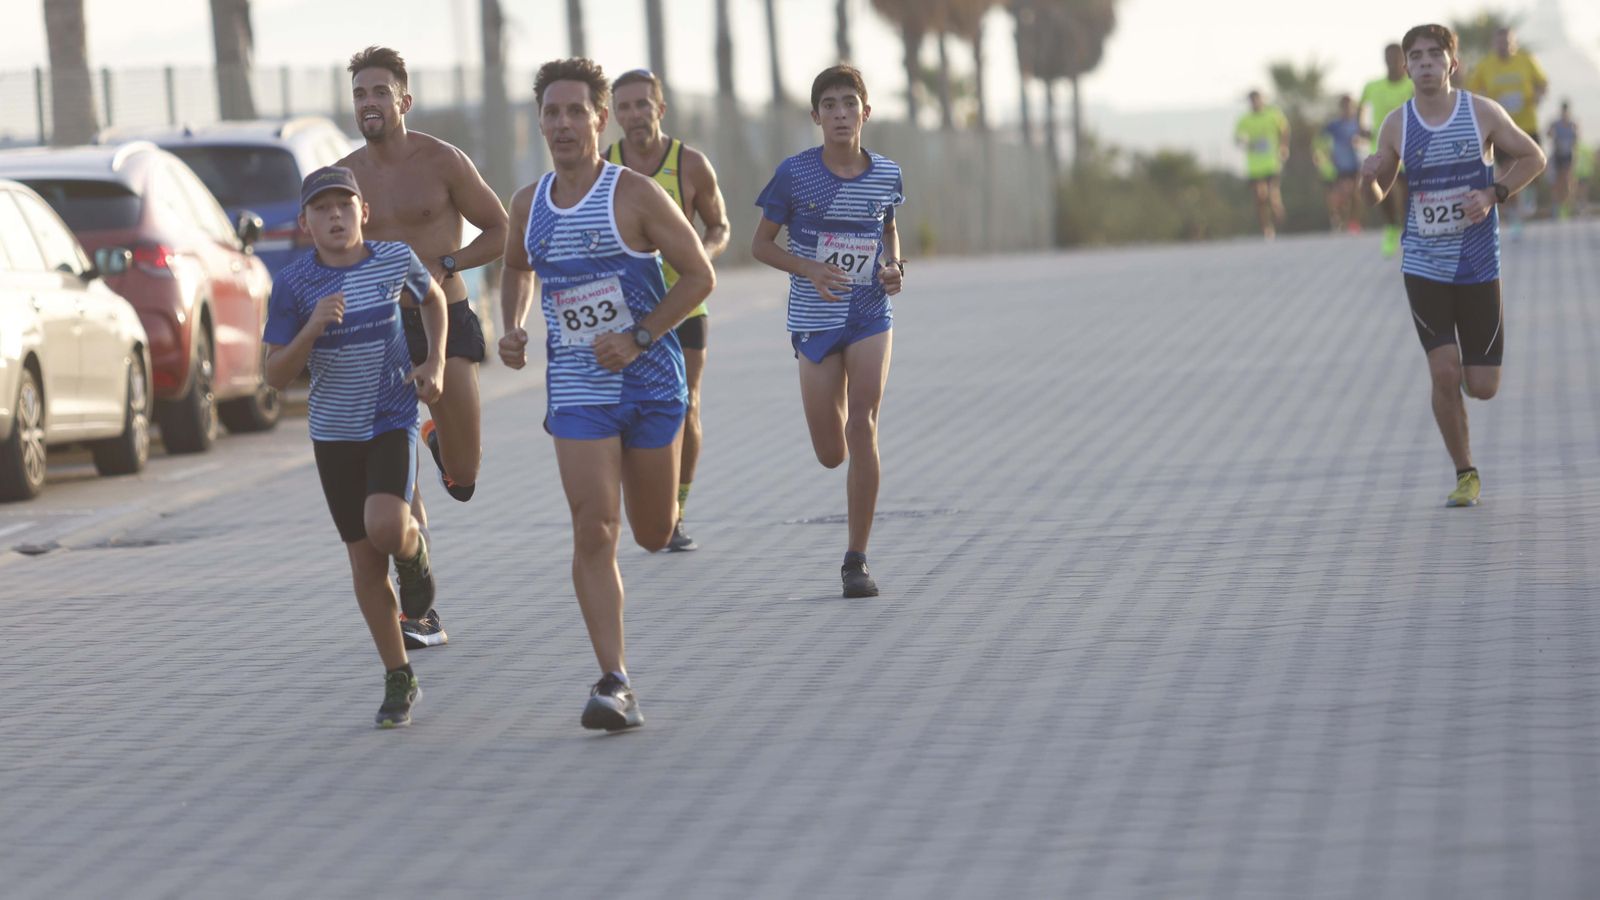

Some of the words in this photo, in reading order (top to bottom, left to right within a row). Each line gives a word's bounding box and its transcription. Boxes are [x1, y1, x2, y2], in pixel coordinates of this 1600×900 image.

[1422, 202, 1466, 225] 925
[824, 252, 870, 274] 497
[562, 299, 618, 331] 833
